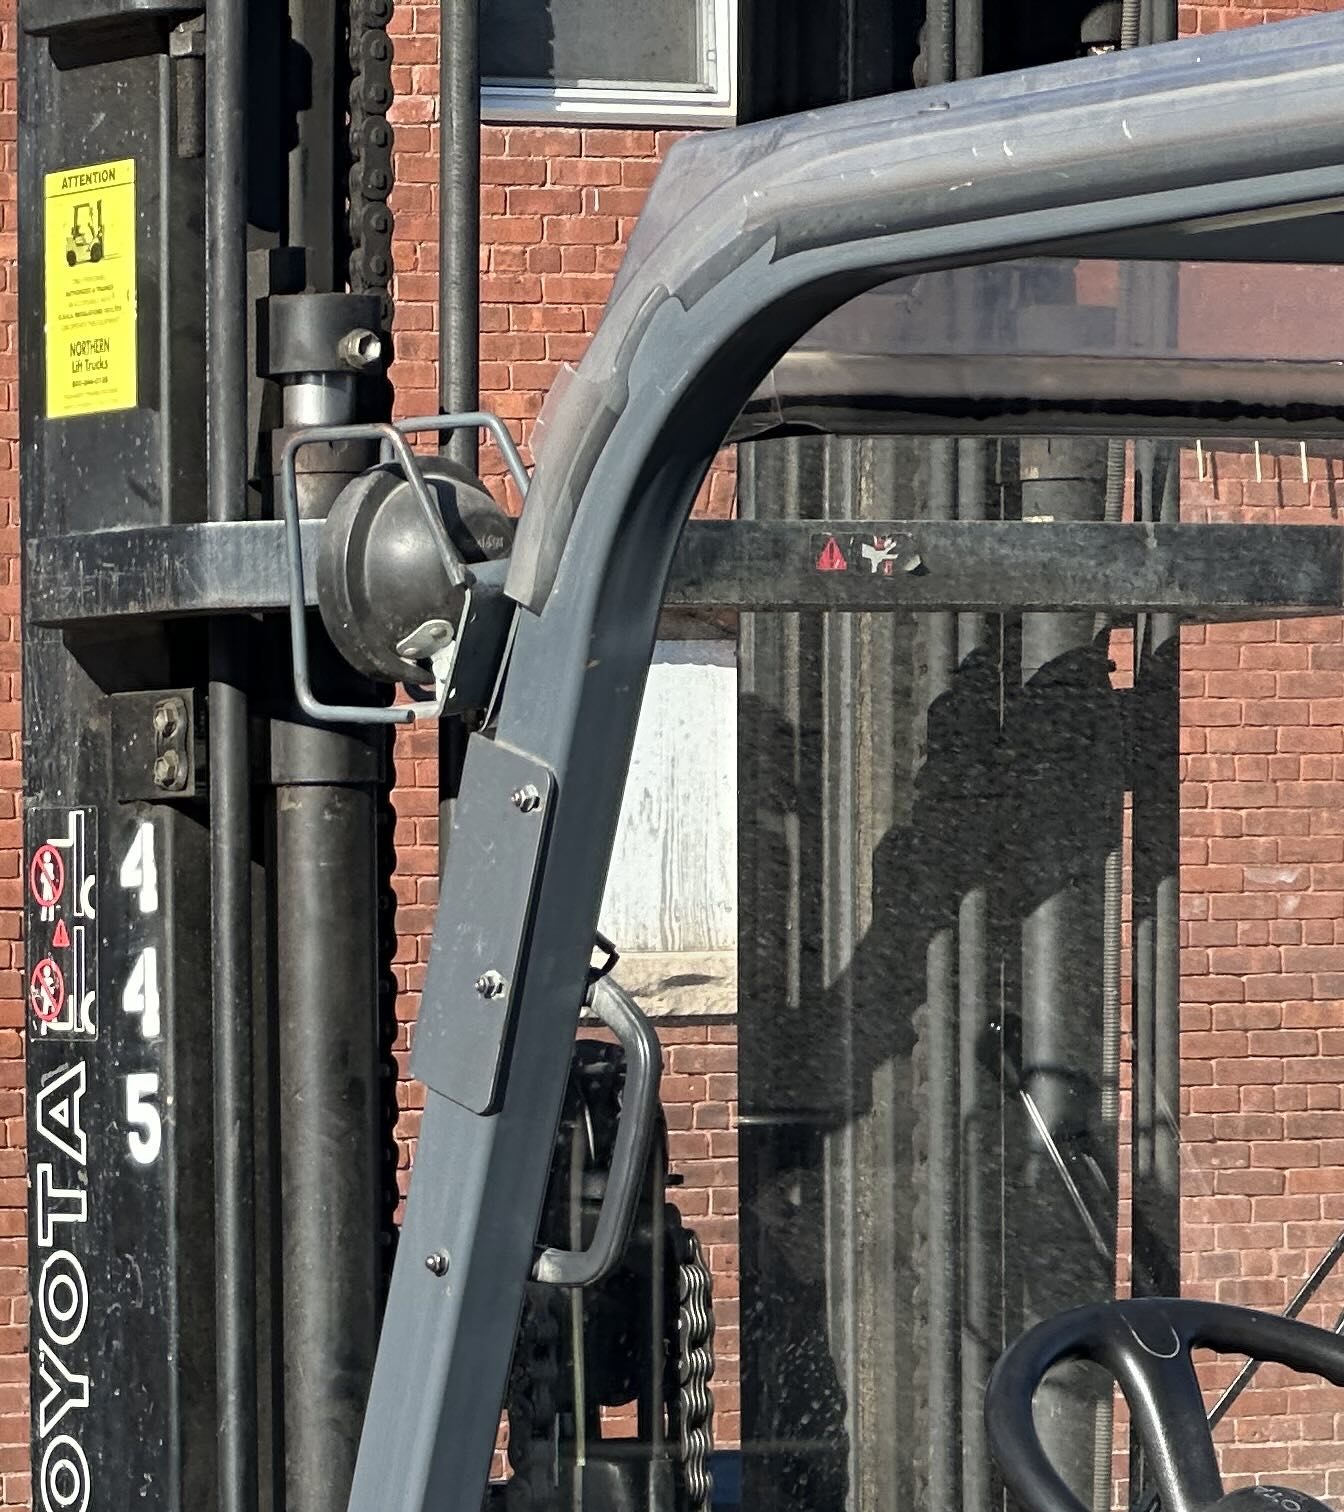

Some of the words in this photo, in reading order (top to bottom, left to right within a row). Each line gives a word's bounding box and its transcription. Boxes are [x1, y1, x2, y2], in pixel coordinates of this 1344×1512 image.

[61, 167, 116, 190] ATTENTION
[69, 336, 111, 357] NORTHERN
[85, 355, 109, 372] Trucks
